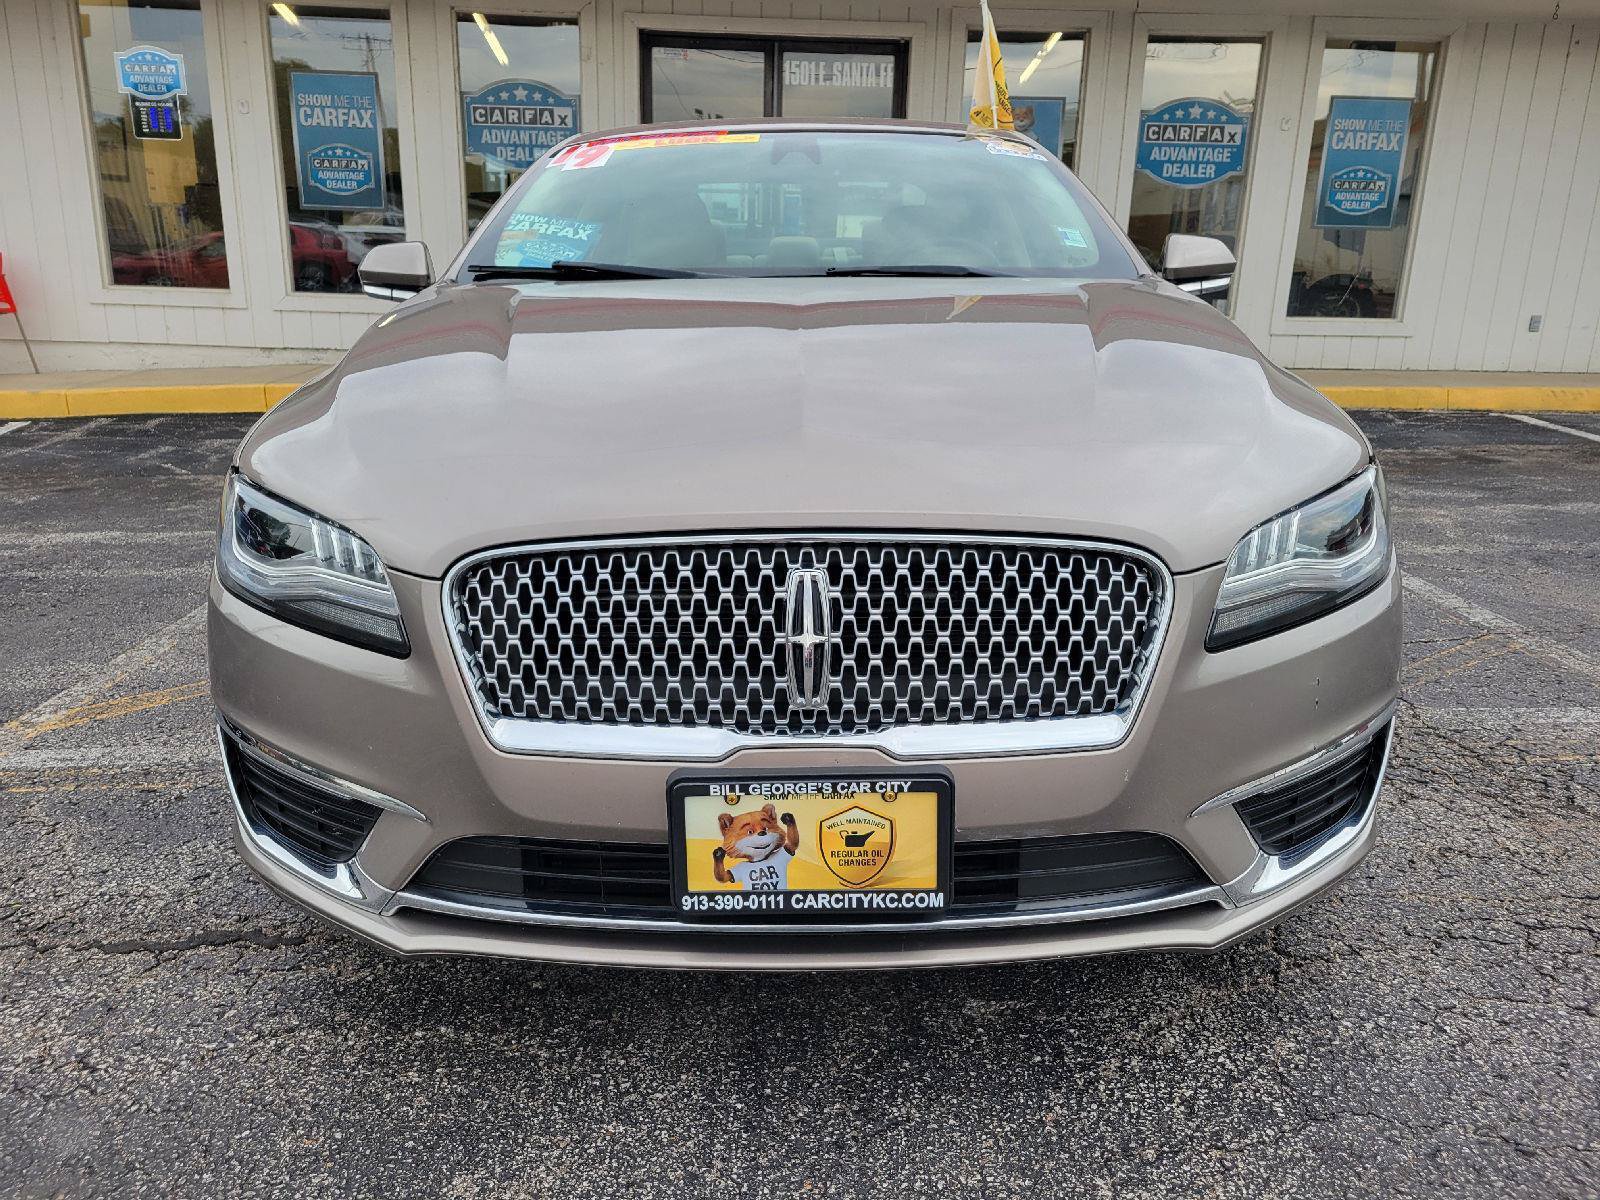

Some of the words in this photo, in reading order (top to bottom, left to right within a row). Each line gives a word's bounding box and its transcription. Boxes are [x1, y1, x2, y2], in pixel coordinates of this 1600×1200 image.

[124, 63, 177, 75] CARFAX
[784, 60, 816, 86] 1501
[832, 61, 876, 87] SANTA
[880, 63, 894, 88] FE
[128, 74, 175, 84] ADVANTAGE
[137, 83, 168, 92] DEALER
[297, 93, 332, 107] SHOW
[334, 95, 350, 108] ME
[352, 96, 374, 109] THE
[300, 107, 374, 129] CARFAX
[473, 107, 571, 127] CARFAX
[1334, 119, 1367, 131] SHOW
[1368, 121, 1383, 132] ME
[1385, 121, 1405, 133] THE
[1147, 125, 1238, 144] CARFAX
[1331, 132, 1402, 151] CARFAX
[496, 146, 546, 161] DEALE
[1149, 146, 1233, 163] ADVANTAGE
[313, 158, 369, 171] CARFAX
[1162, 162, 1216, 178] DEALER
[318, 170, 365, 180] ADVANTAGE
[326, 180, 358, 190] DEALER
[1333, 180, 1386, 192] CARFAX
[1335, 192, 1380, 201] ADVANTAGE
[1341, 201, 1371, 209] DEALER
[708, 784, 746, 797] BILL
[748, 782, 833, 796] GEORGE'S
[836, 781, 872, 794] CAR
[875, 781, 912, 793] CITY
[826, 820, 845, 831] WELL
[845, 818, 886, 830] MAINTAINED
[830, 850, 870, 859] REGULAR
[871, 849, 884, 858] OIL
[838, 858, 877, 867] CHANGES
[748, 865, 780, 882] CAR
[681, 894, 784, 911] 913-390-0111
[790, 892, 944, 909] CARCITYKC.COM
